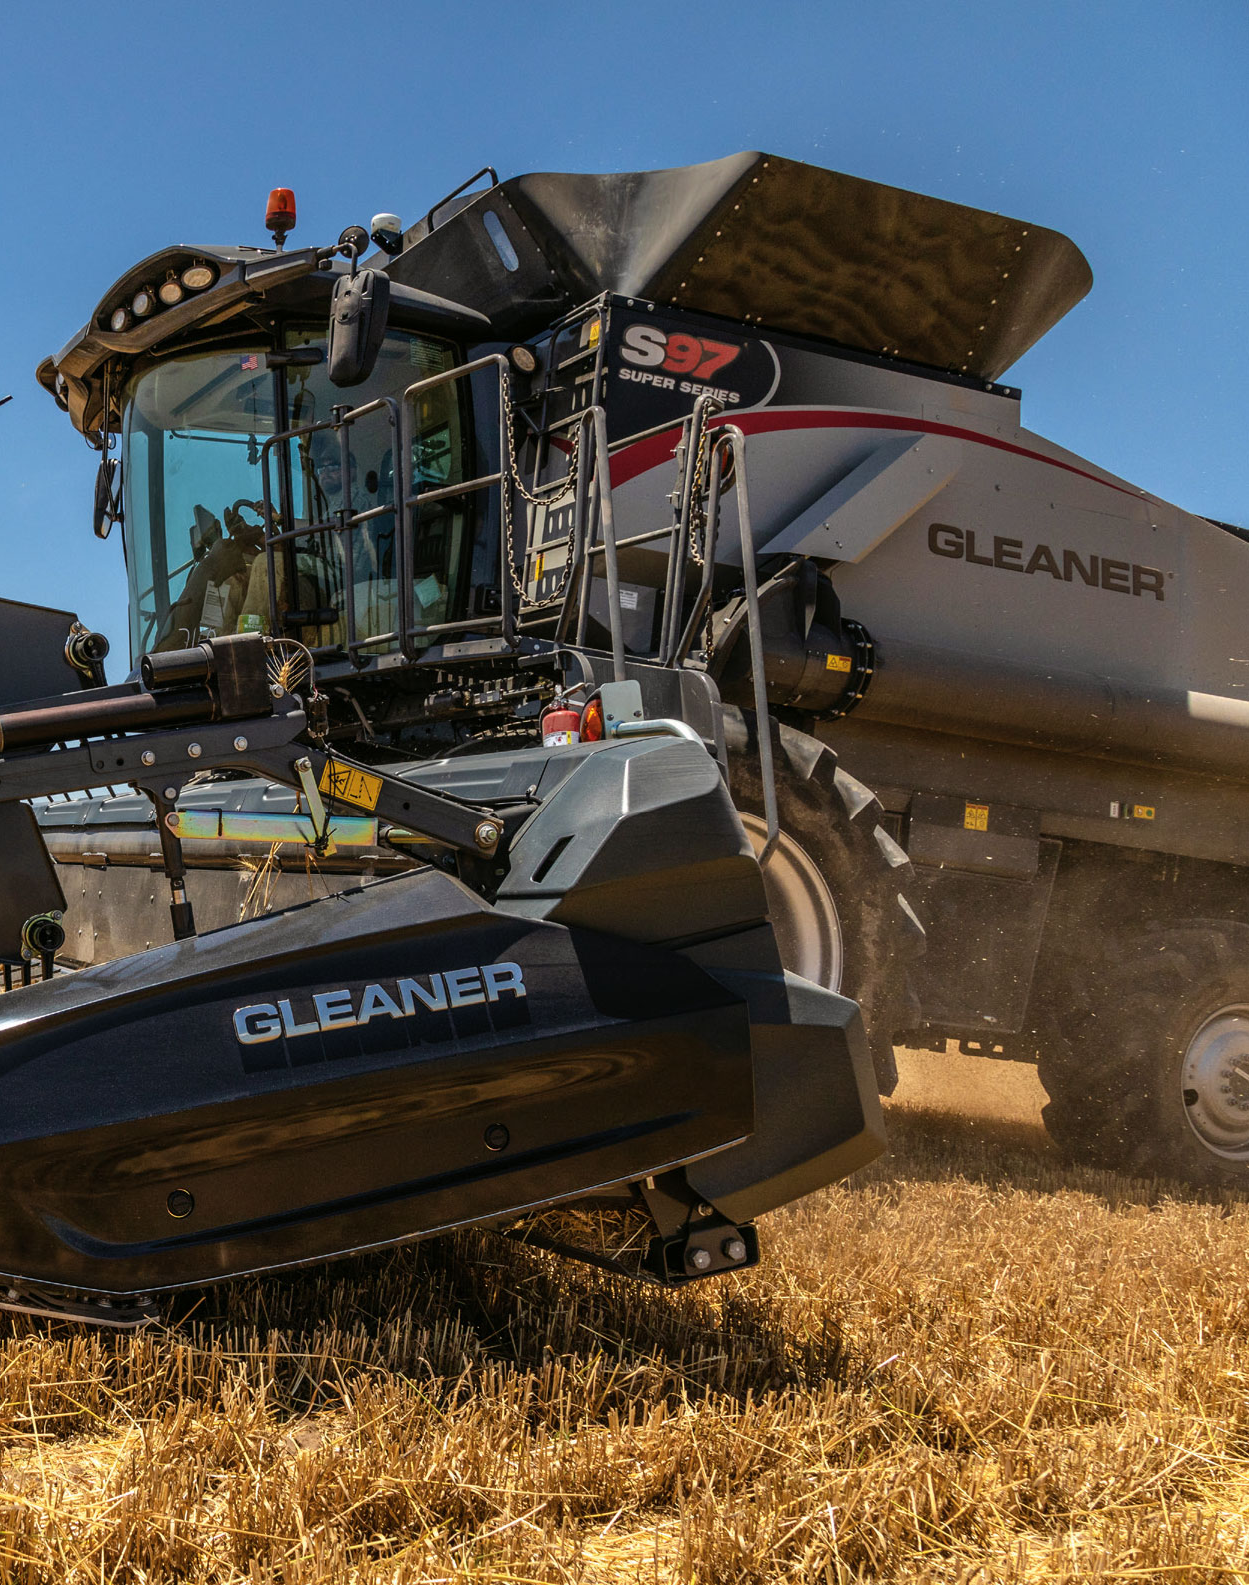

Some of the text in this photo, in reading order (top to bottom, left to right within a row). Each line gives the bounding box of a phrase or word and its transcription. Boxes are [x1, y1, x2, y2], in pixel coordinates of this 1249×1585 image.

[620, 325, 741, 379] S97
[618, 368, 740, 403] SUPER SERIES
[928, 523, 1165, 600] GLEANER
[232, 961, 527, 1045] GLEANER
